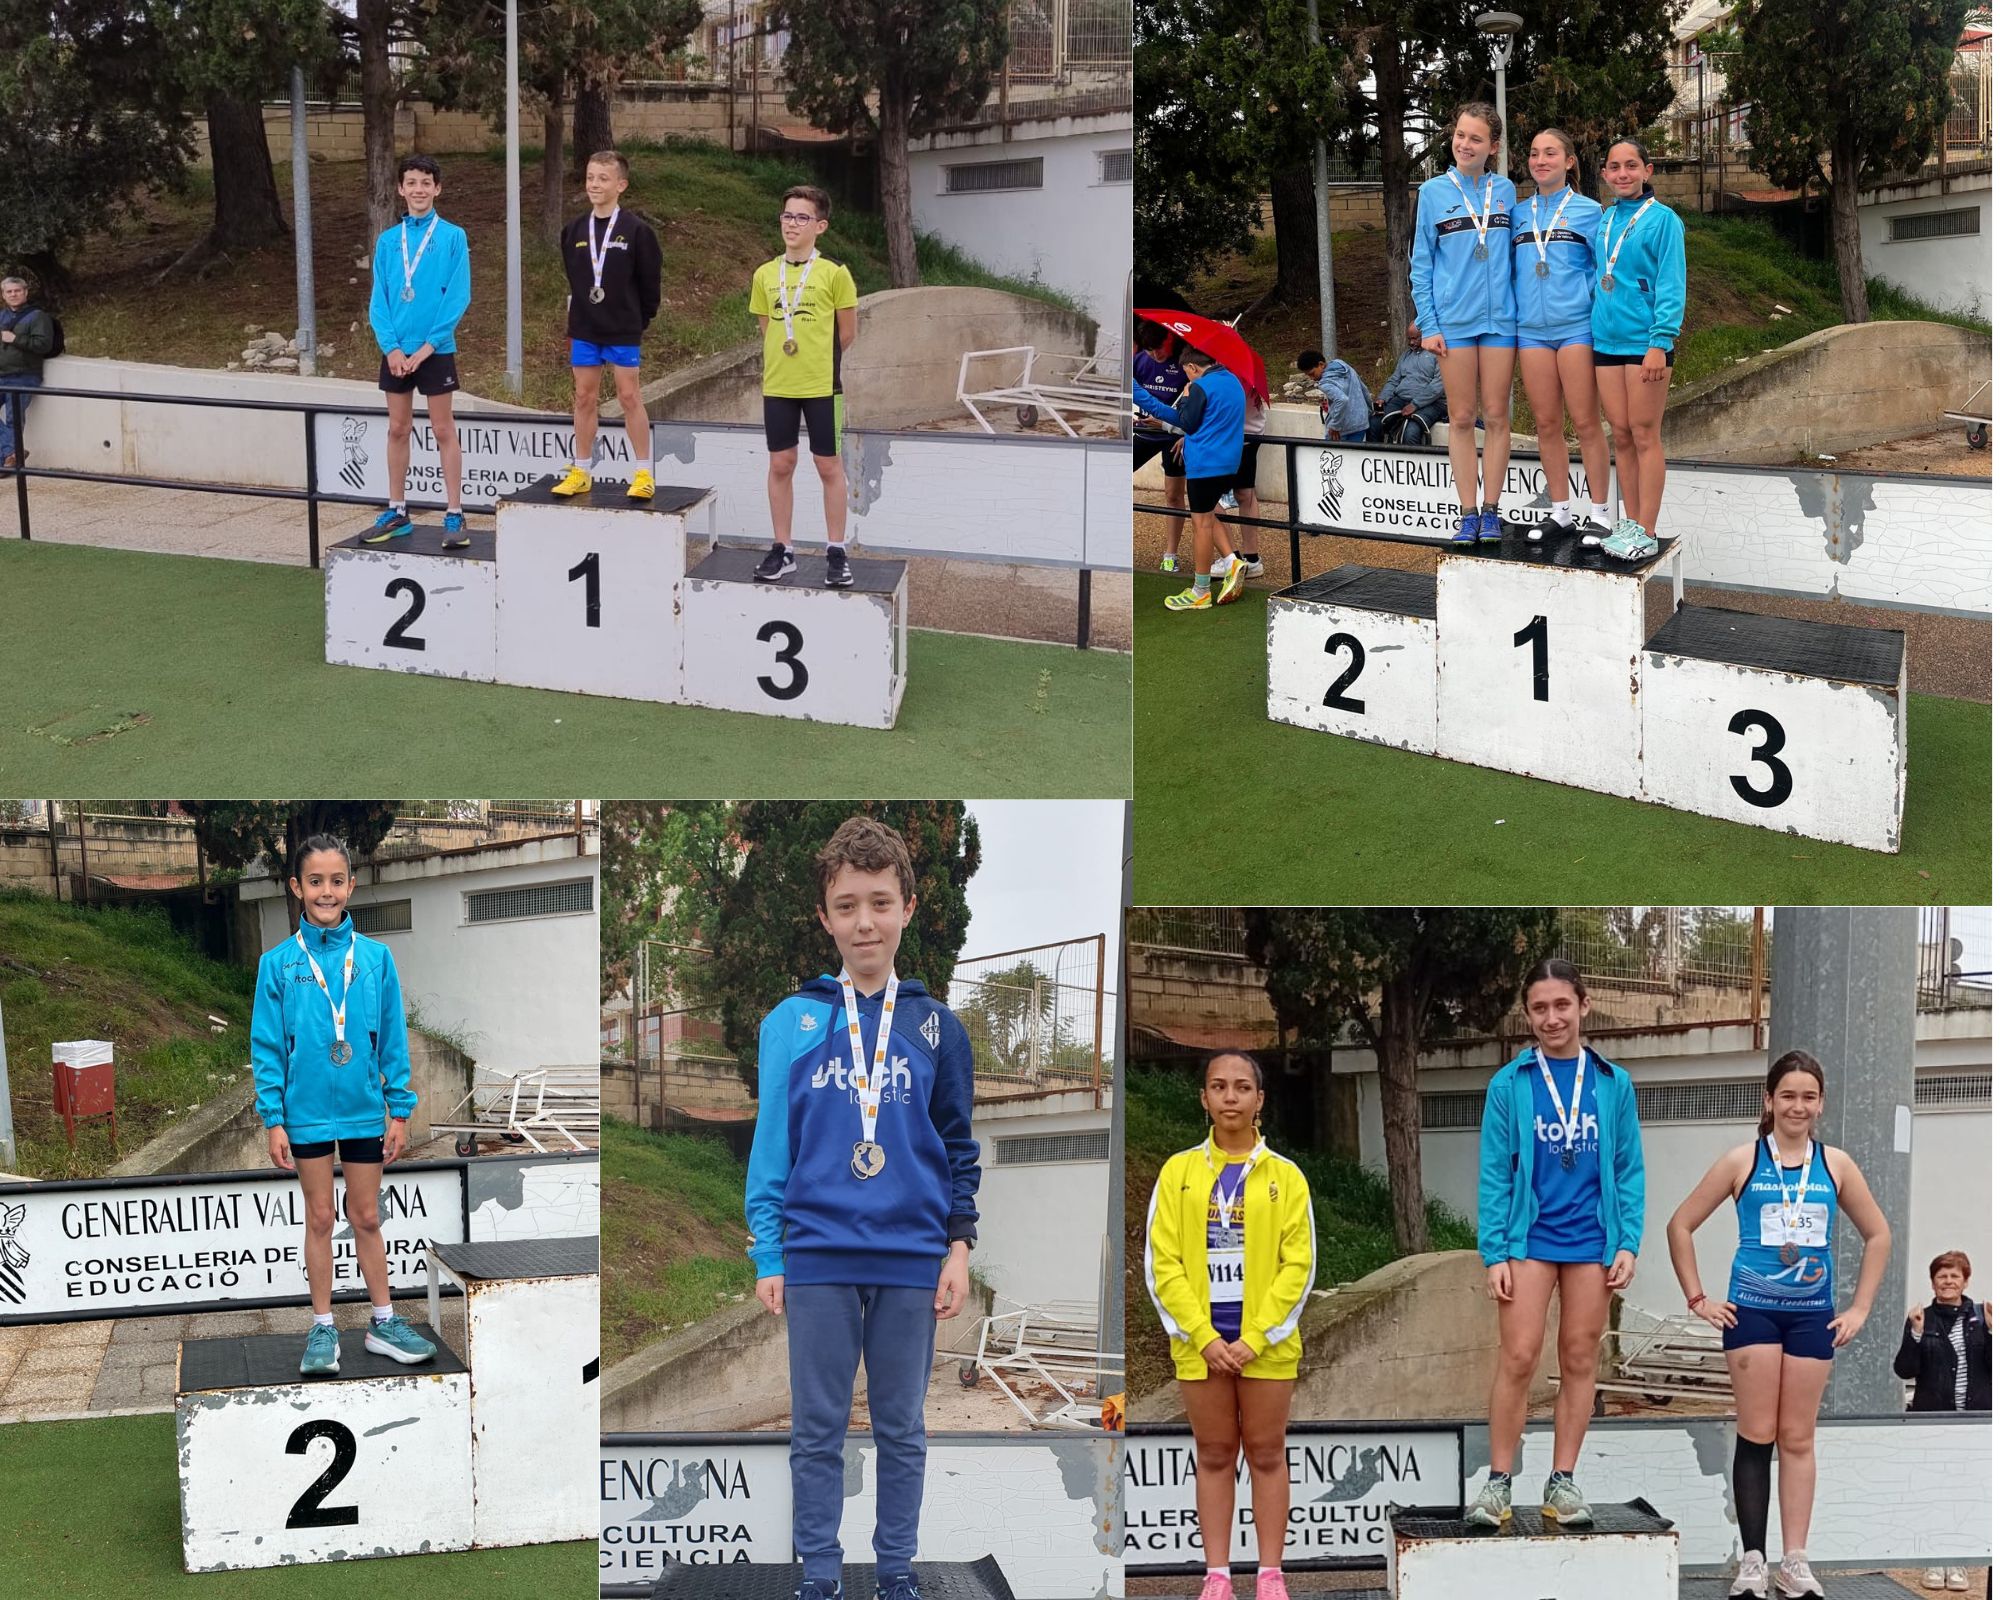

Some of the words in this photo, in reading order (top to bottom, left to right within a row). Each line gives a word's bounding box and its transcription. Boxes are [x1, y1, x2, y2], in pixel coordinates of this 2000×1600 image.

[411, 426, 501, 455] NELITAT
[508, 430, 629, 462] VALENCNA
[404, 480, 498, 497] DUCCIÓ
[406, 465, 509, 483] NSEERIA
[514, 471, 538, 485] DE
[1361, 457, 1456, 489] GENERALIT
[1362, 496, 1464, 516] CONSELLERI
[1508, 508, 1593, 528] CULTRA
[568, 552, 601, 628] 1
[382, 577, 426, 651] 2
[756, 620, 809, 700] 3
[1322, 632, 1366, 715] 2
[1513, 614, 1549, 702] 1
[1727, 708, 1793, 808] 3
[849, 1087, 911, 1105] lostic
[1533, 1112, 1599, 1143] tok
[1548, 1141, 1599, 1155] lostic
[61, 1193, 242, 1240] GENERALITAT
[64, 1249, 257, 1277] CONSELLERIA
[264, 1246, 299, 1264] DE
[66, 1267, 240, 1298] EDUCACIÓ
[266, 1268, 272, 1284] I
[285, 1418, 360, 1530] 2
[1124, 1448, 1198, 1487] ALITA
[1124, 1509, 1200, 1528] LLER
[1238, 1508, 1255, 1525] D
[1288, 1505, 1390, 1524] CULTU
[602, 1524, 753, 1544] CULTURA
[1240, 1530, 1247, 1548] I
[1283, 1526, 1385, 1547] CIENC
[600, 1548, 751, 1568] CIENCIA
